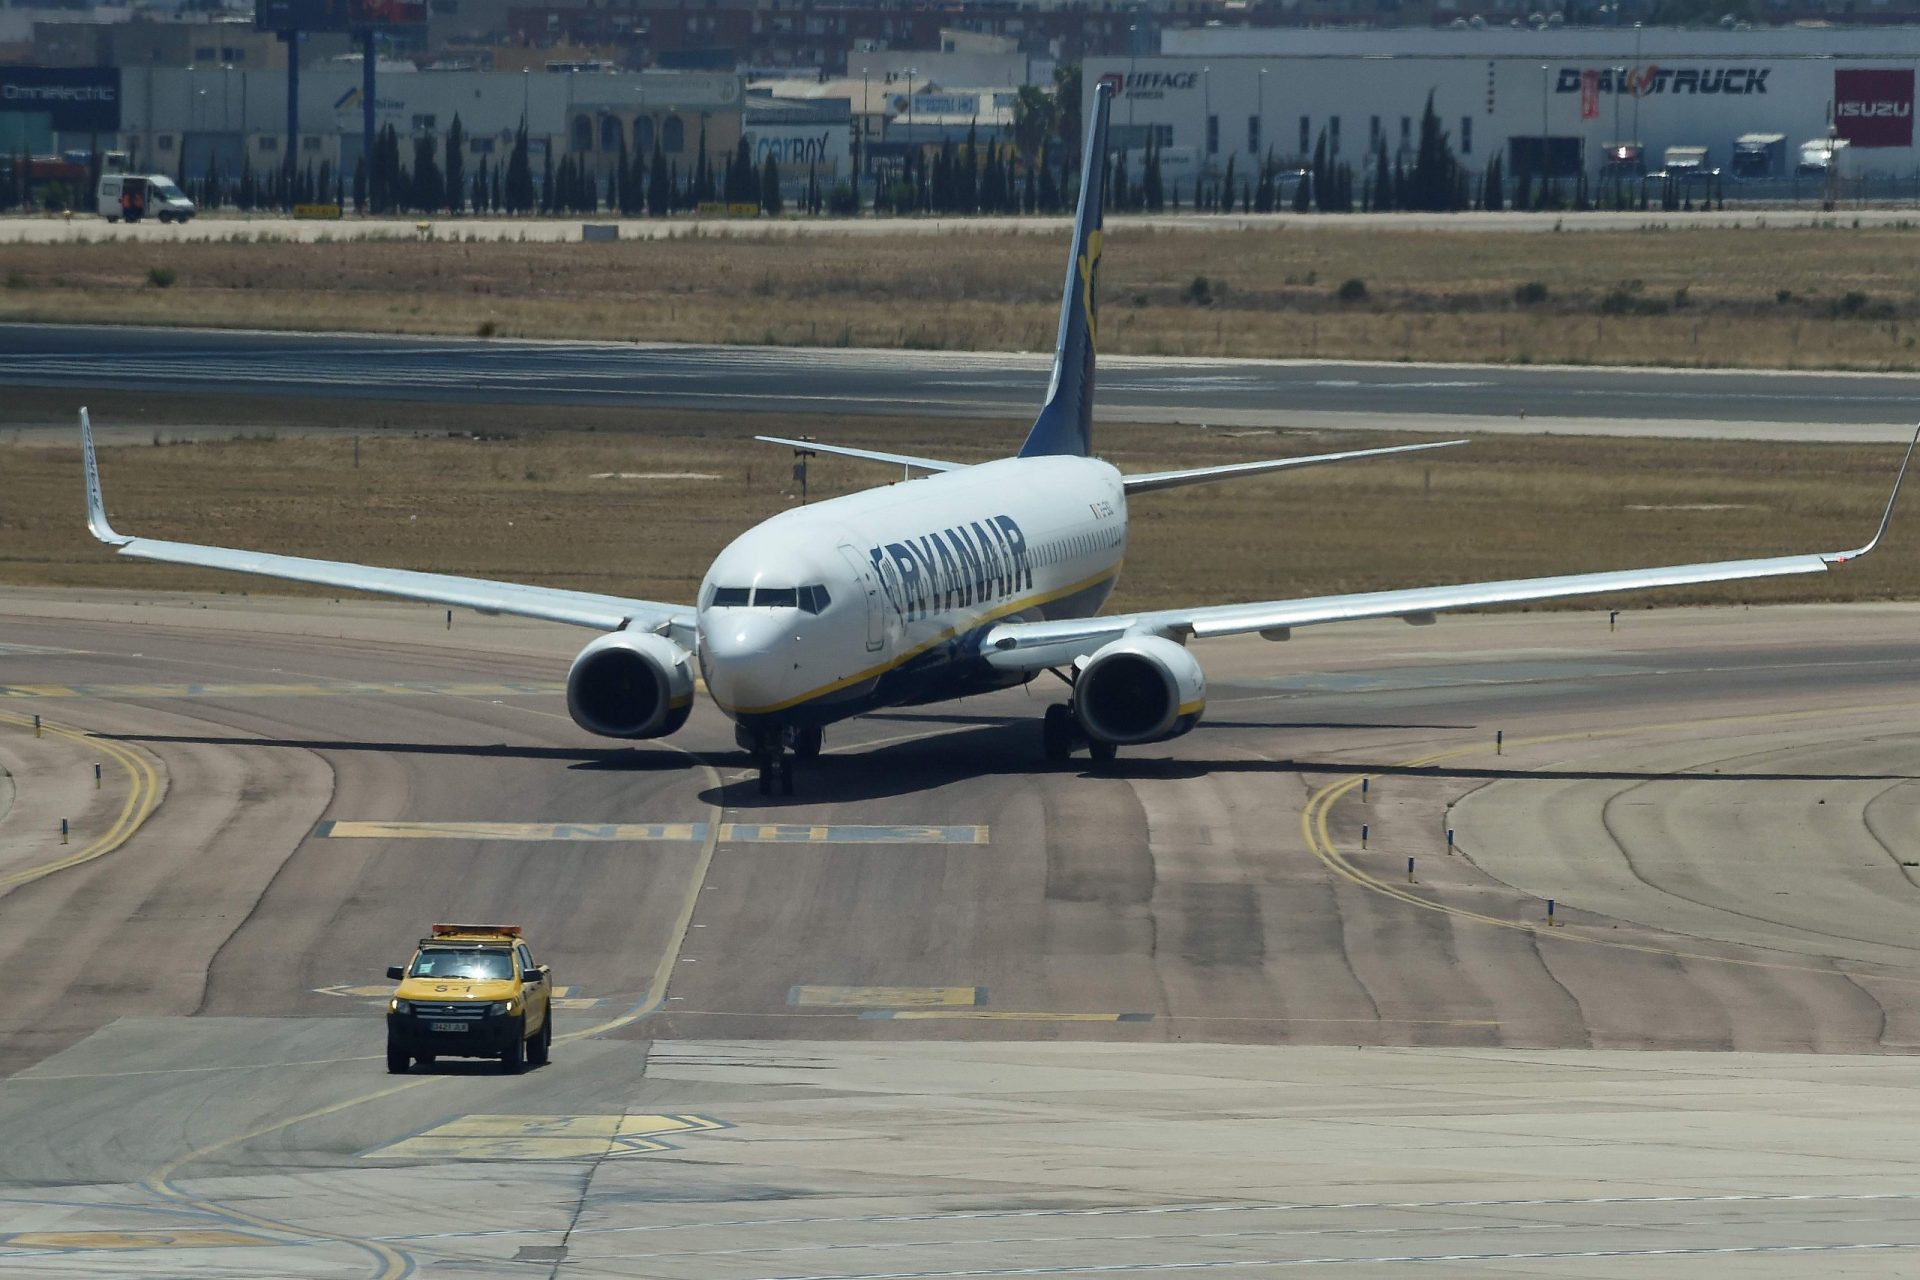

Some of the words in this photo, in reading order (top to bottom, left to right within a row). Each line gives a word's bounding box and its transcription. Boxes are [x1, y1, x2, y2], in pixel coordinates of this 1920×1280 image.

[1125, 72, 1198, 89] EIFFAGE
[1838, 102, 1910, 117] ISUZU
[885, 514, 1033, 623] RYANAIR
